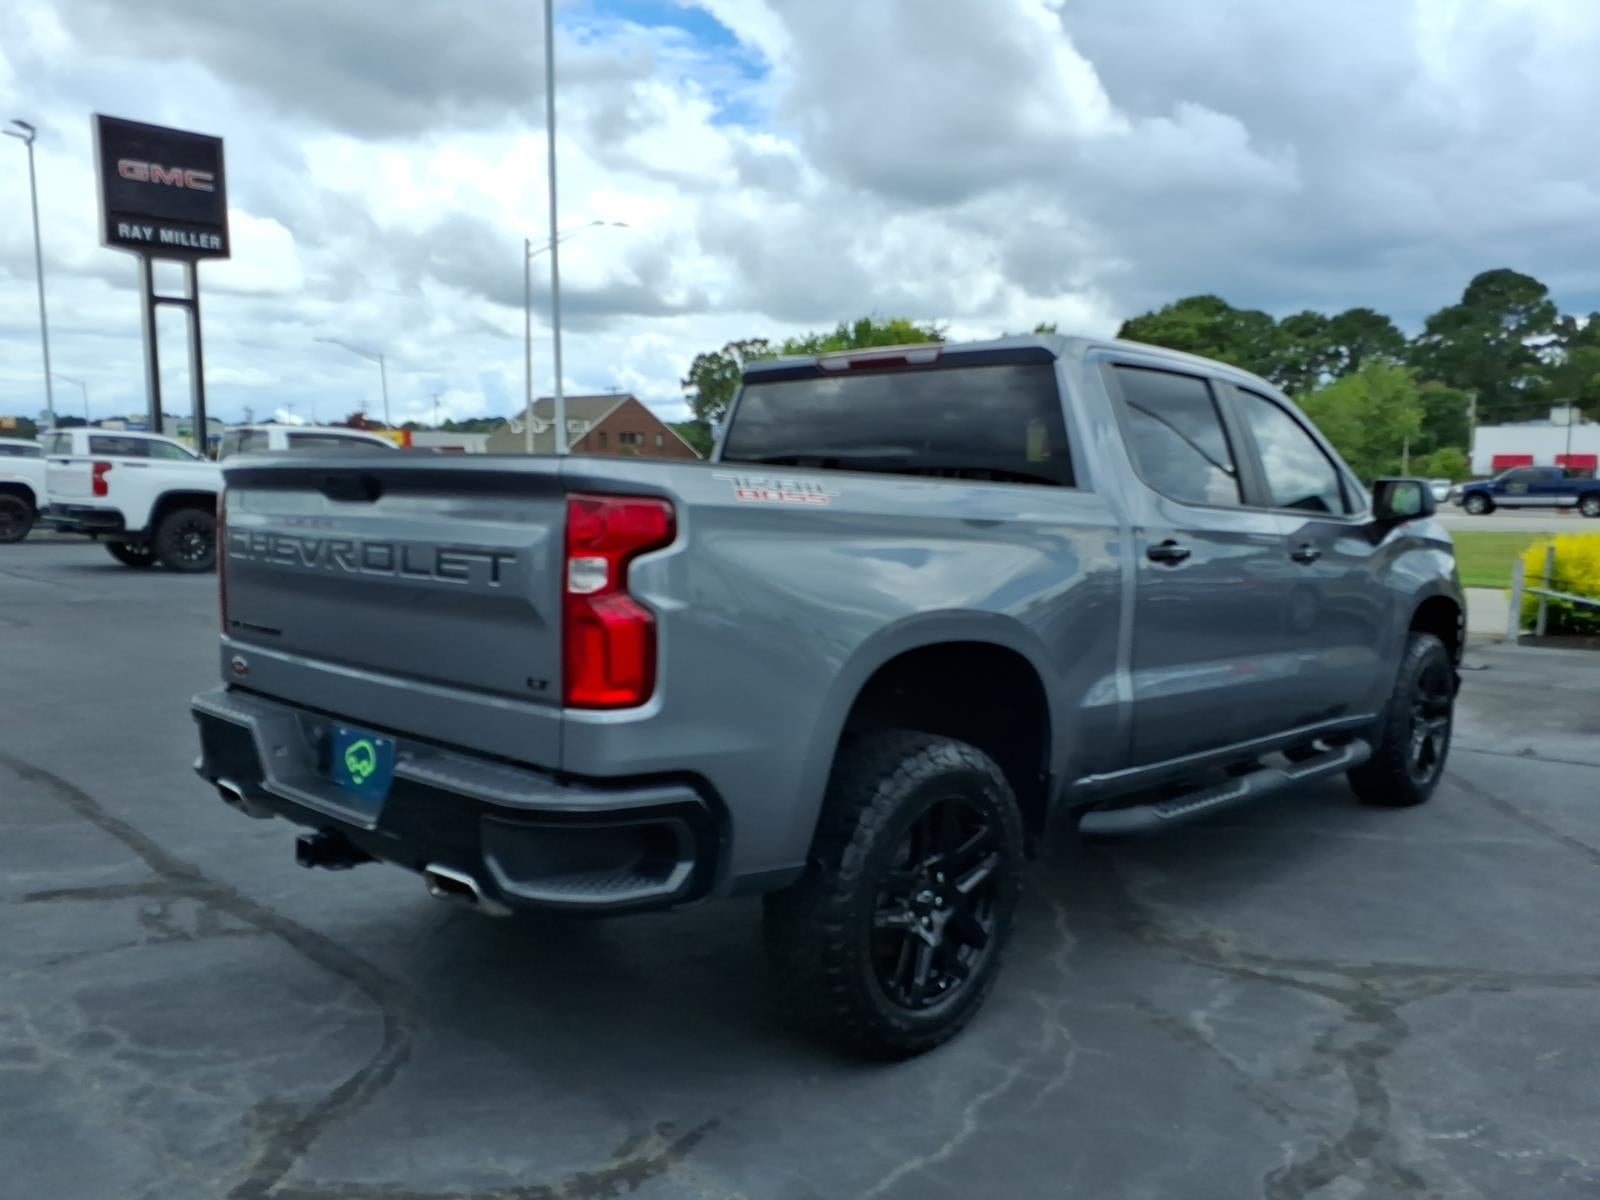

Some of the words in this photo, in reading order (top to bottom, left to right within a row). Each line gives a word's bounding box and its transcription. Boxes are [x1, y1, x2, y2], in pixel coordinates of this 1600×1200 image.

[117, 158, 215, 192] GMC
[117, 222, 153, 241] RAY
[159, 228, 221, 249] MILLER
[228, 530, 518, 587] CHEVROLET
